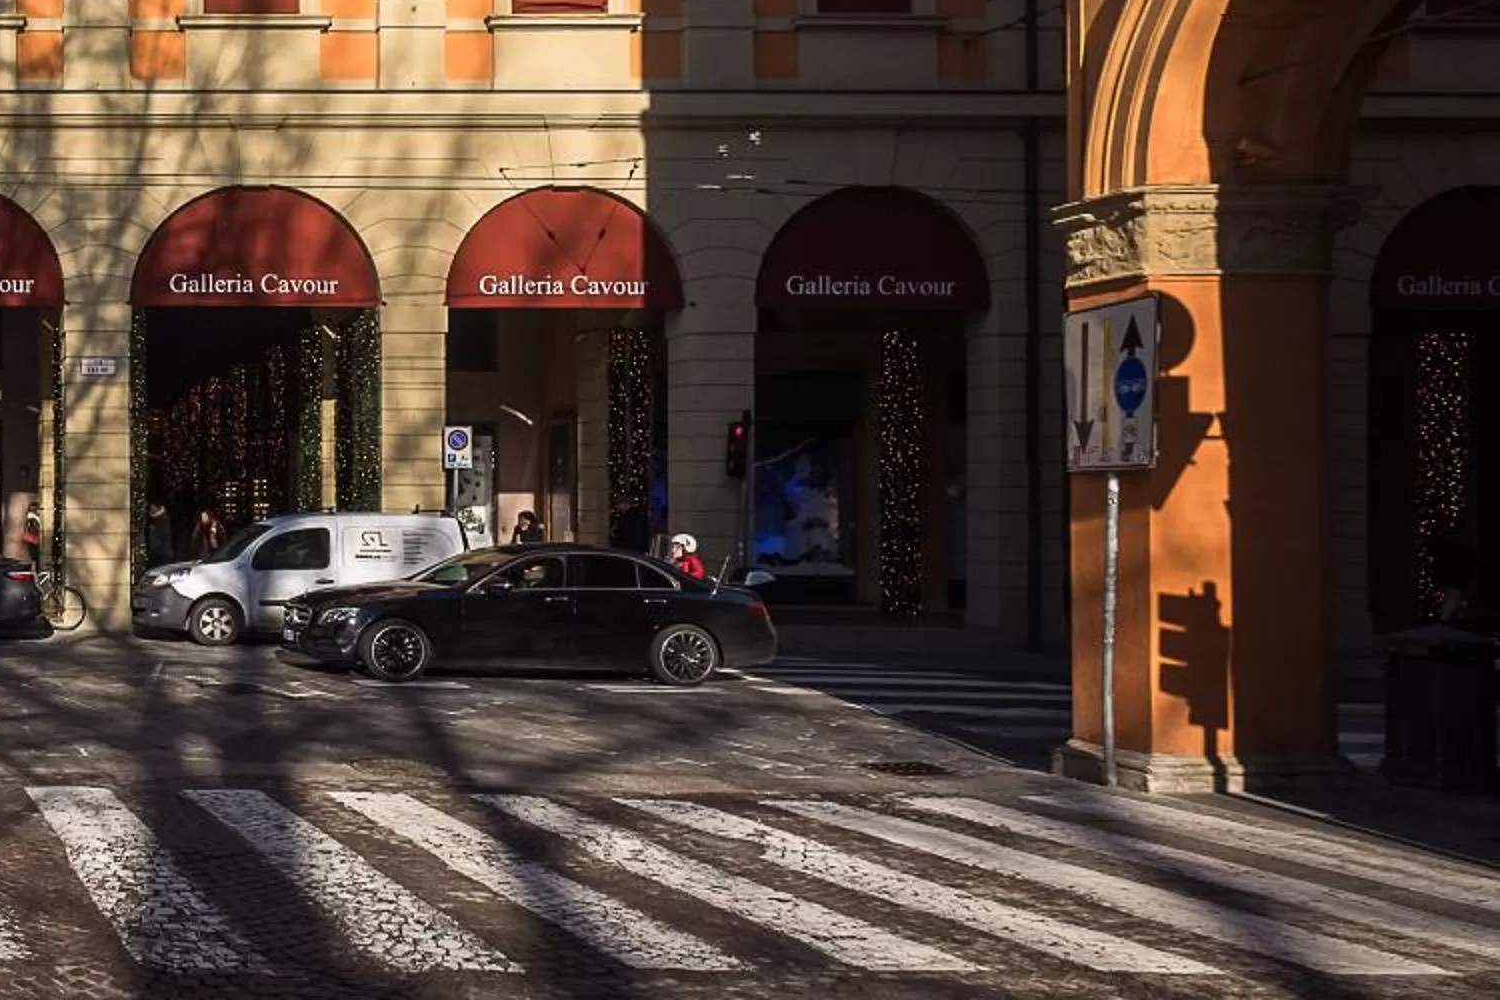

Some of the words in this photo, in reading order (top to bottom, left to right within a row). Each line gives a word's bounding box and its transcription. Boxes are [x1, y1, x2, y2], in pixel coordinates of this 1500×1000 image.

[169, 273, 254, 294] Galleria
[261, 273, 339, 294] Cavour
[479, 274, 565, 295] Galleria
[571, 275, 649, 295] Cavour
[786, 275, 871, 296] Galleria
[878, 275, 956, 296] Cavour
[1396, 275, 1481, 296] Galleria
